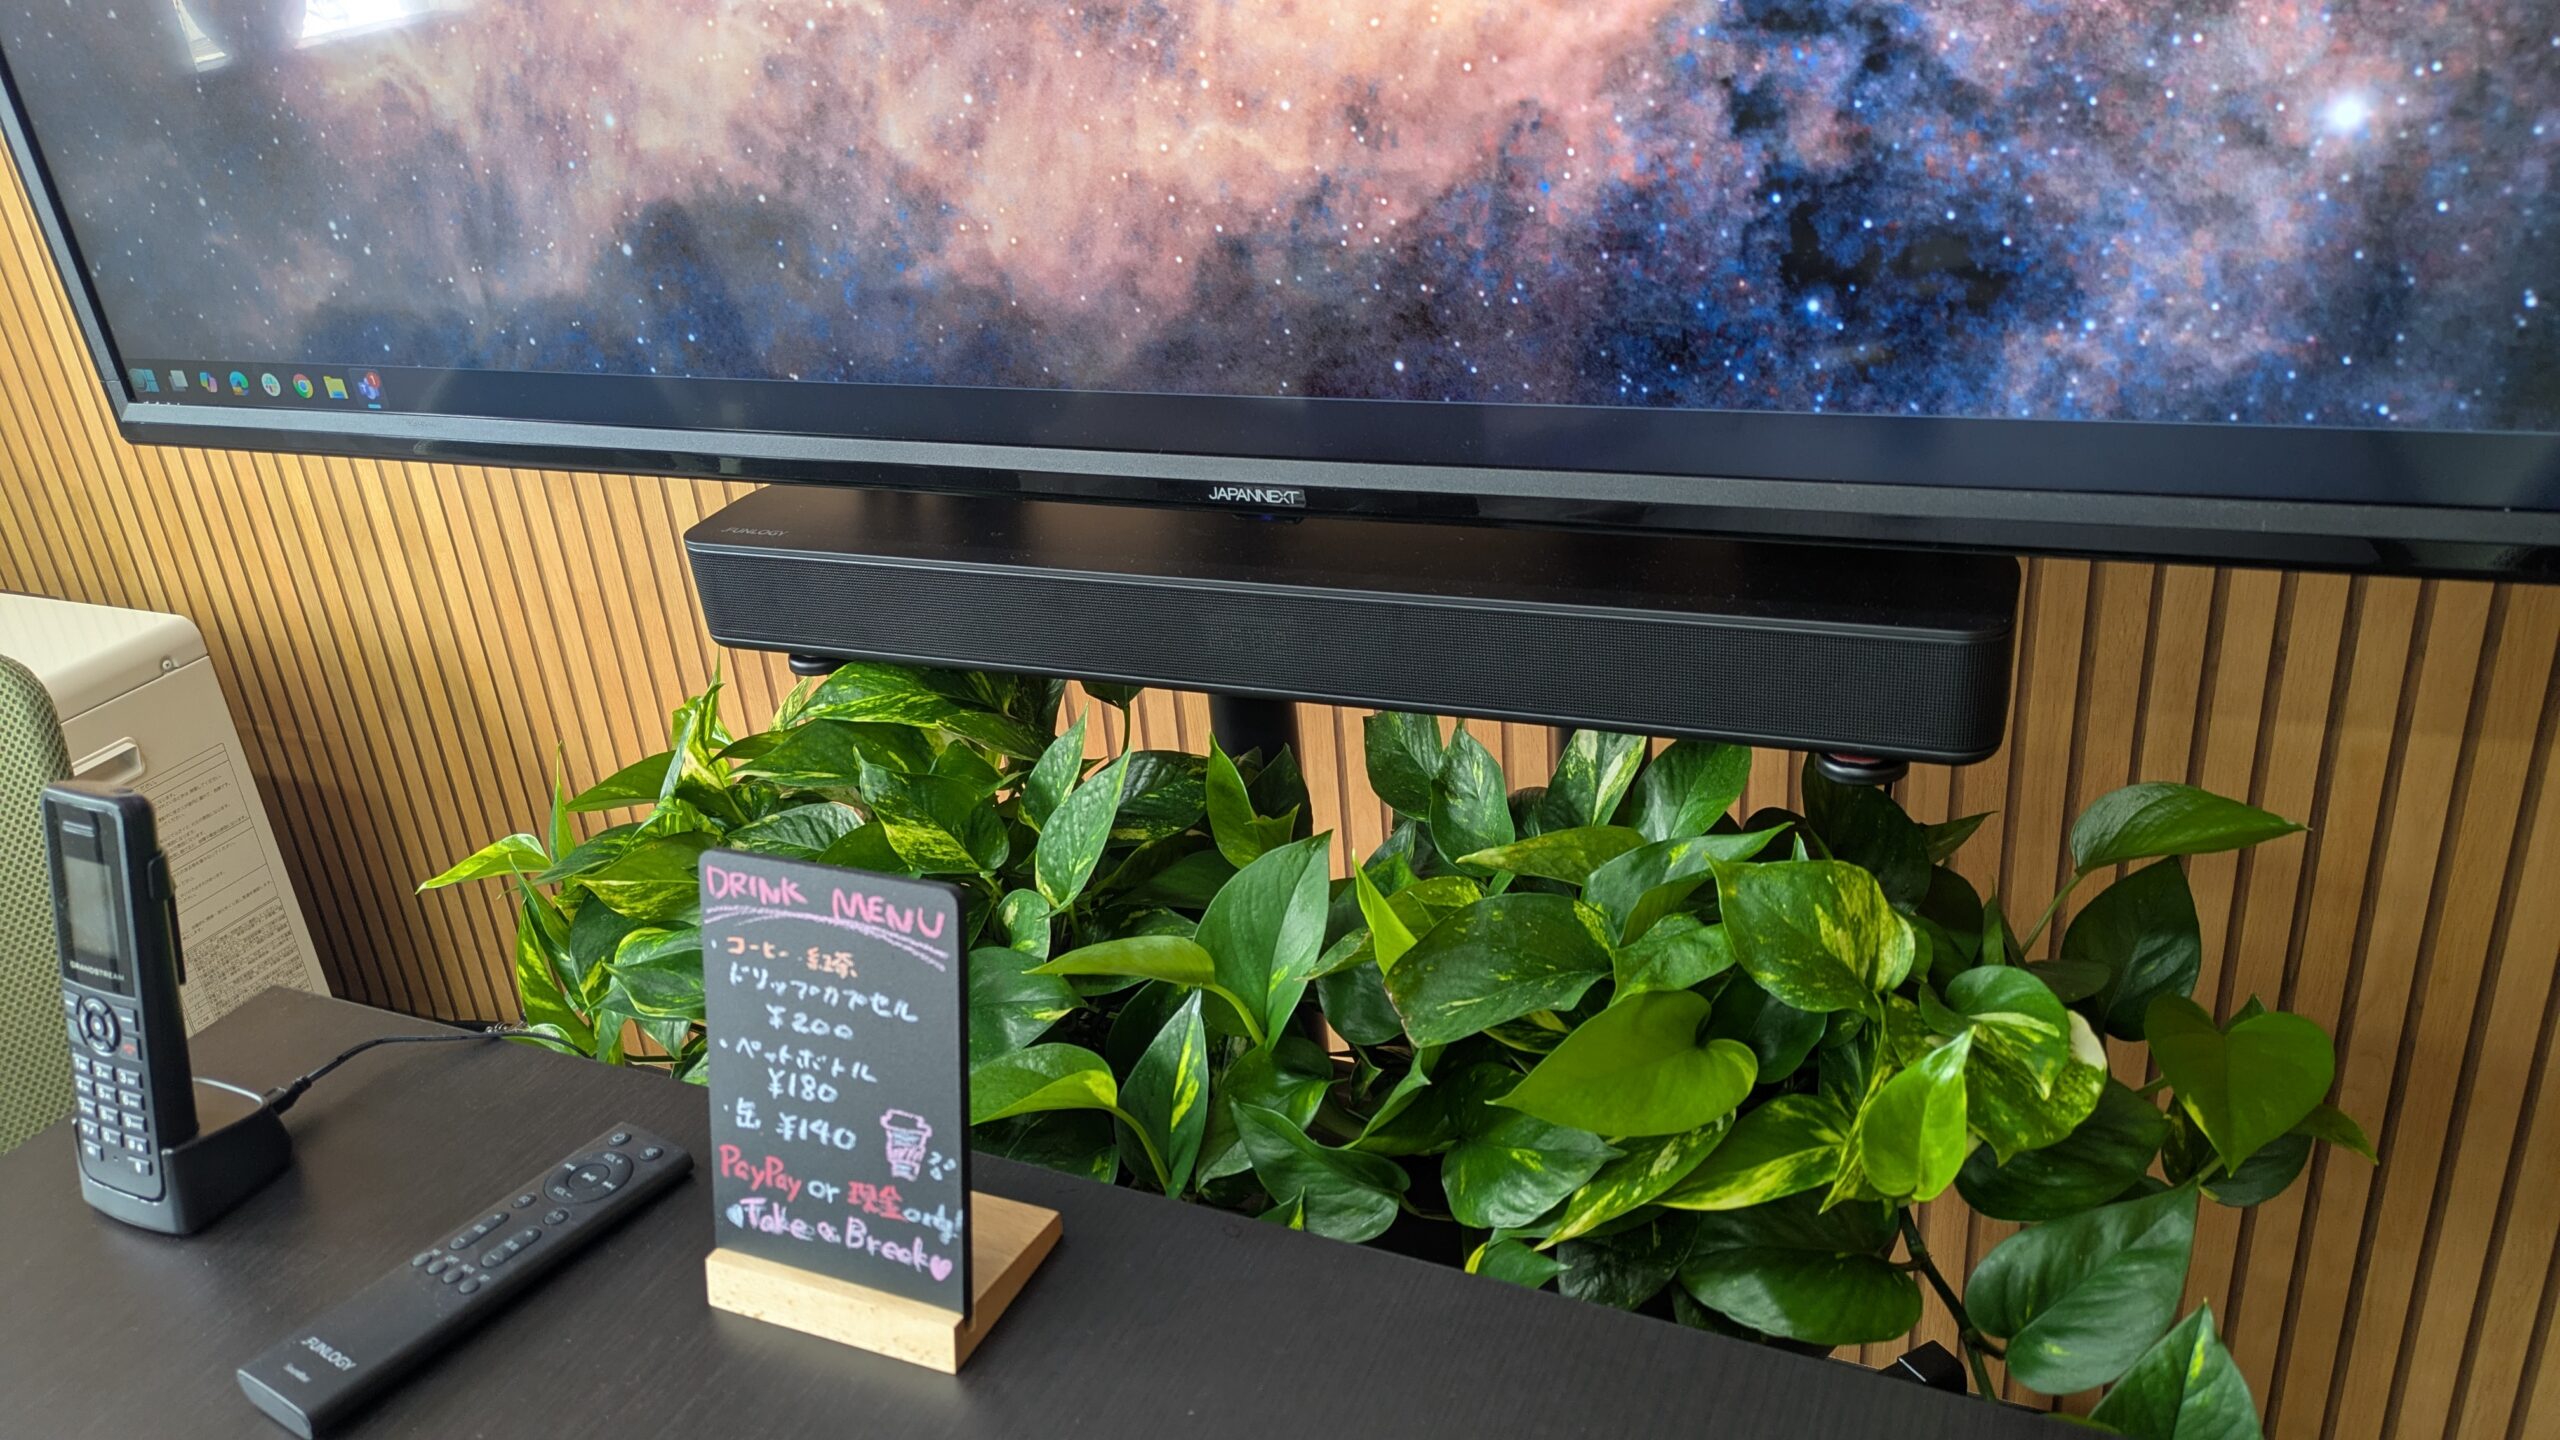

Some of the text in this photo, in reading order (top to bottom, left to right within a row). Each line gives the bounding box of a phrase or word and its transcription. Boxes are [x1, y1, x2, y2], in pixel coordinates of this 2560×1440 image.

[1209, 486, 1299, 504] JAPANNEXT
[706, 865, 945, 938] DRINK MENU
[766, 1003, 853, 1040] ¥200
[767, 1067, 838, 1103] ¥180
[775, 1111, 857, 1150] ¥140
[719, 1144, 802, 1202] PayPay
[807, 1179, 840, 1203] or
[739, 1197, 815, 1242] Take
[845, 1215, 930, 1272] Break
[301, 1336, 357, 1371] FUNLOGY
